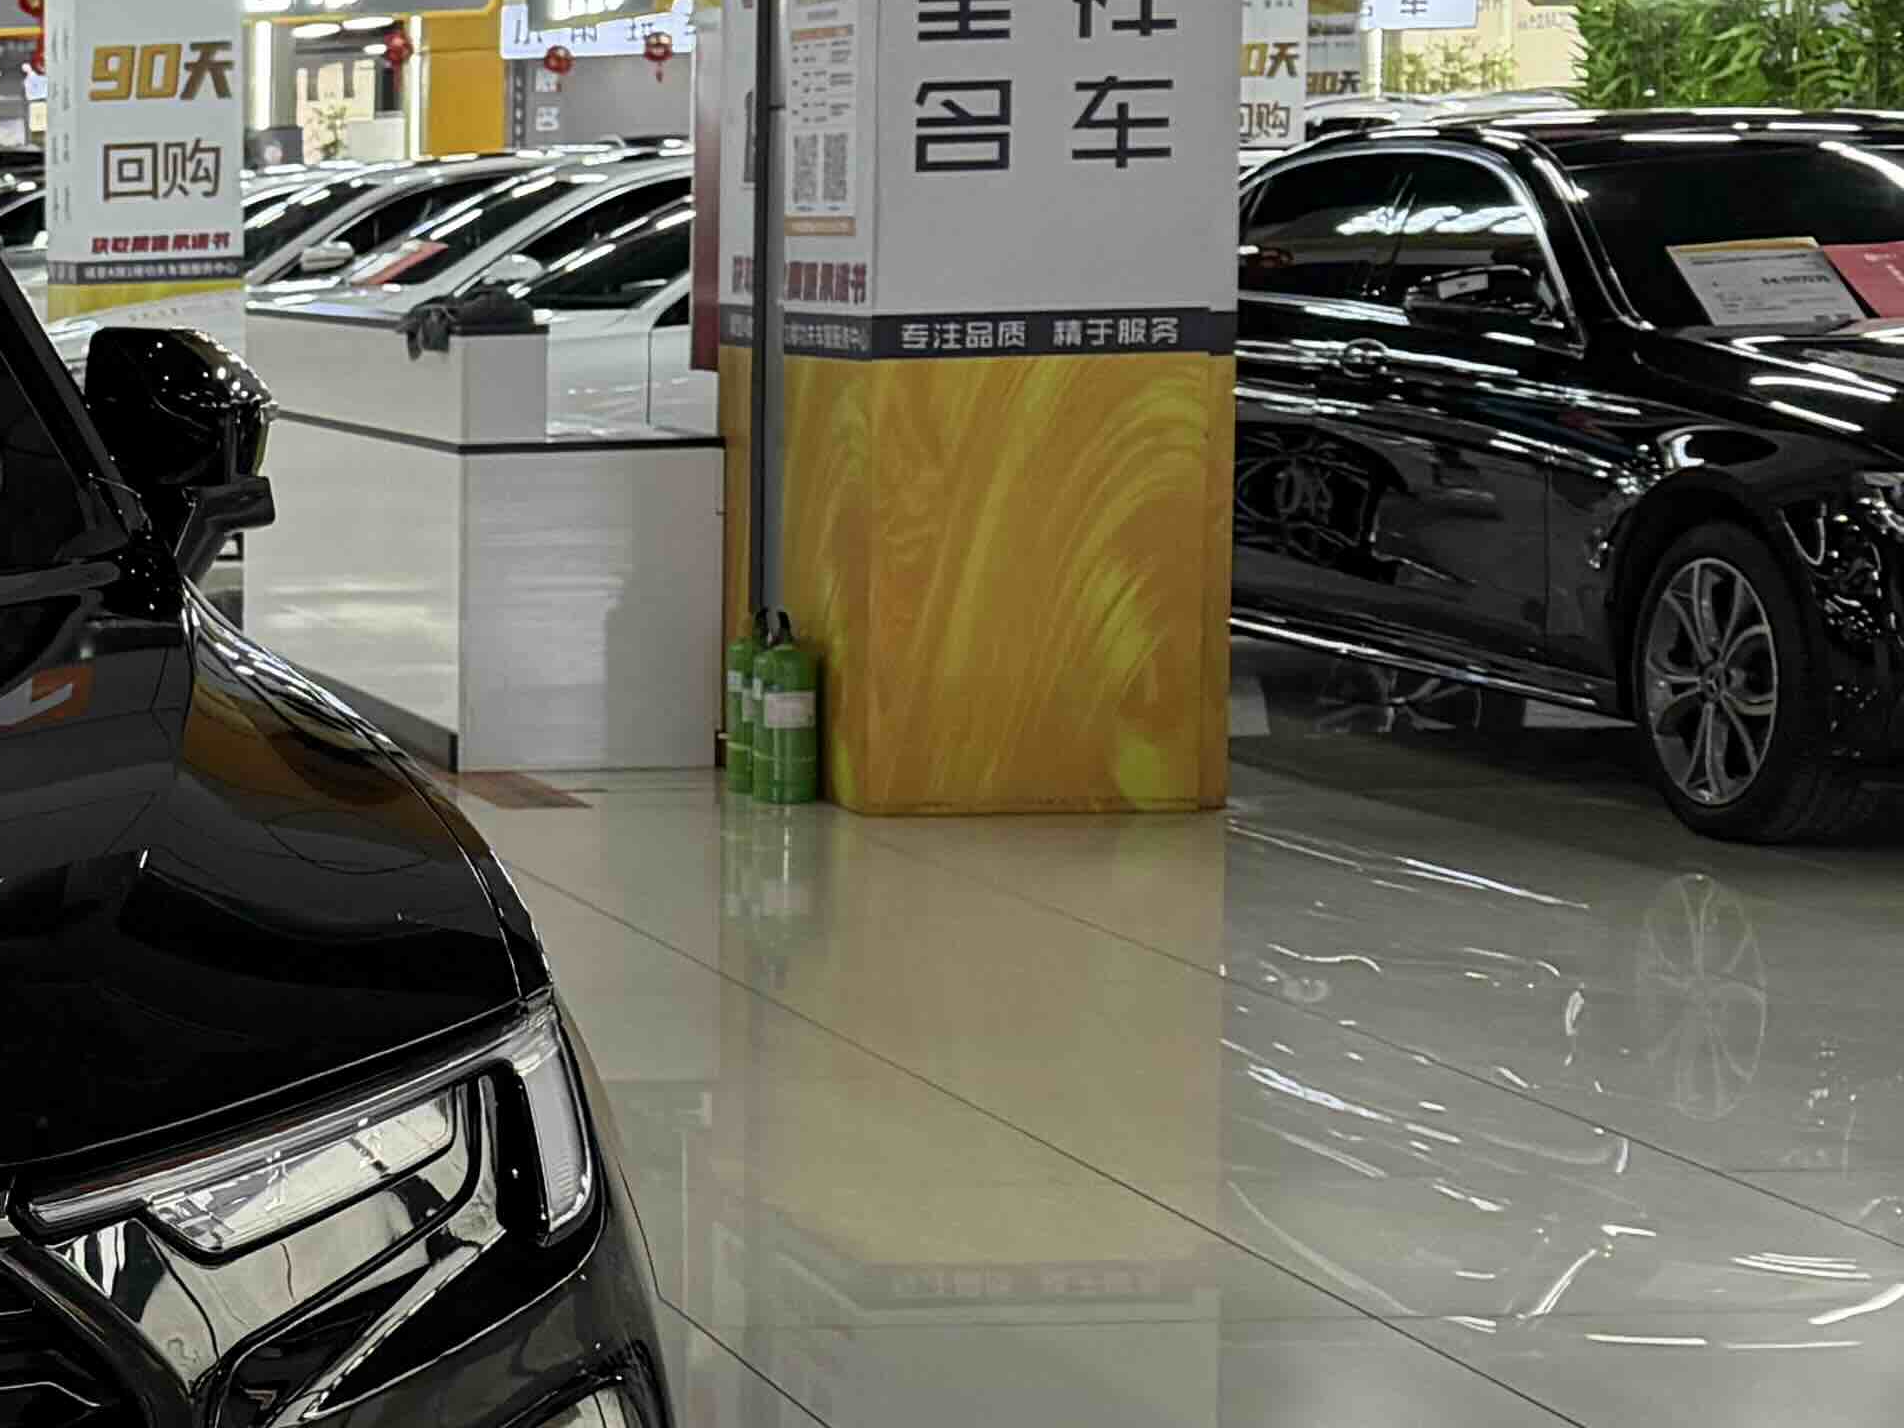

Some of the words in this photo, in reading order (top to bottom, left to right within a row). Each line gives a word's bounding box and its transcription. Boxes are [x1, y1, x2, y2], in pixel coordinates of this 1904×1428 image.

[88, 39, 234, 102] 90天
[915, 76, 1173, 172] 名车
[102, 138, 222, 202] 回购
[900, 319, 1027, 351] 专注品质
[1053, 316, 1180, 347] 精于服务
